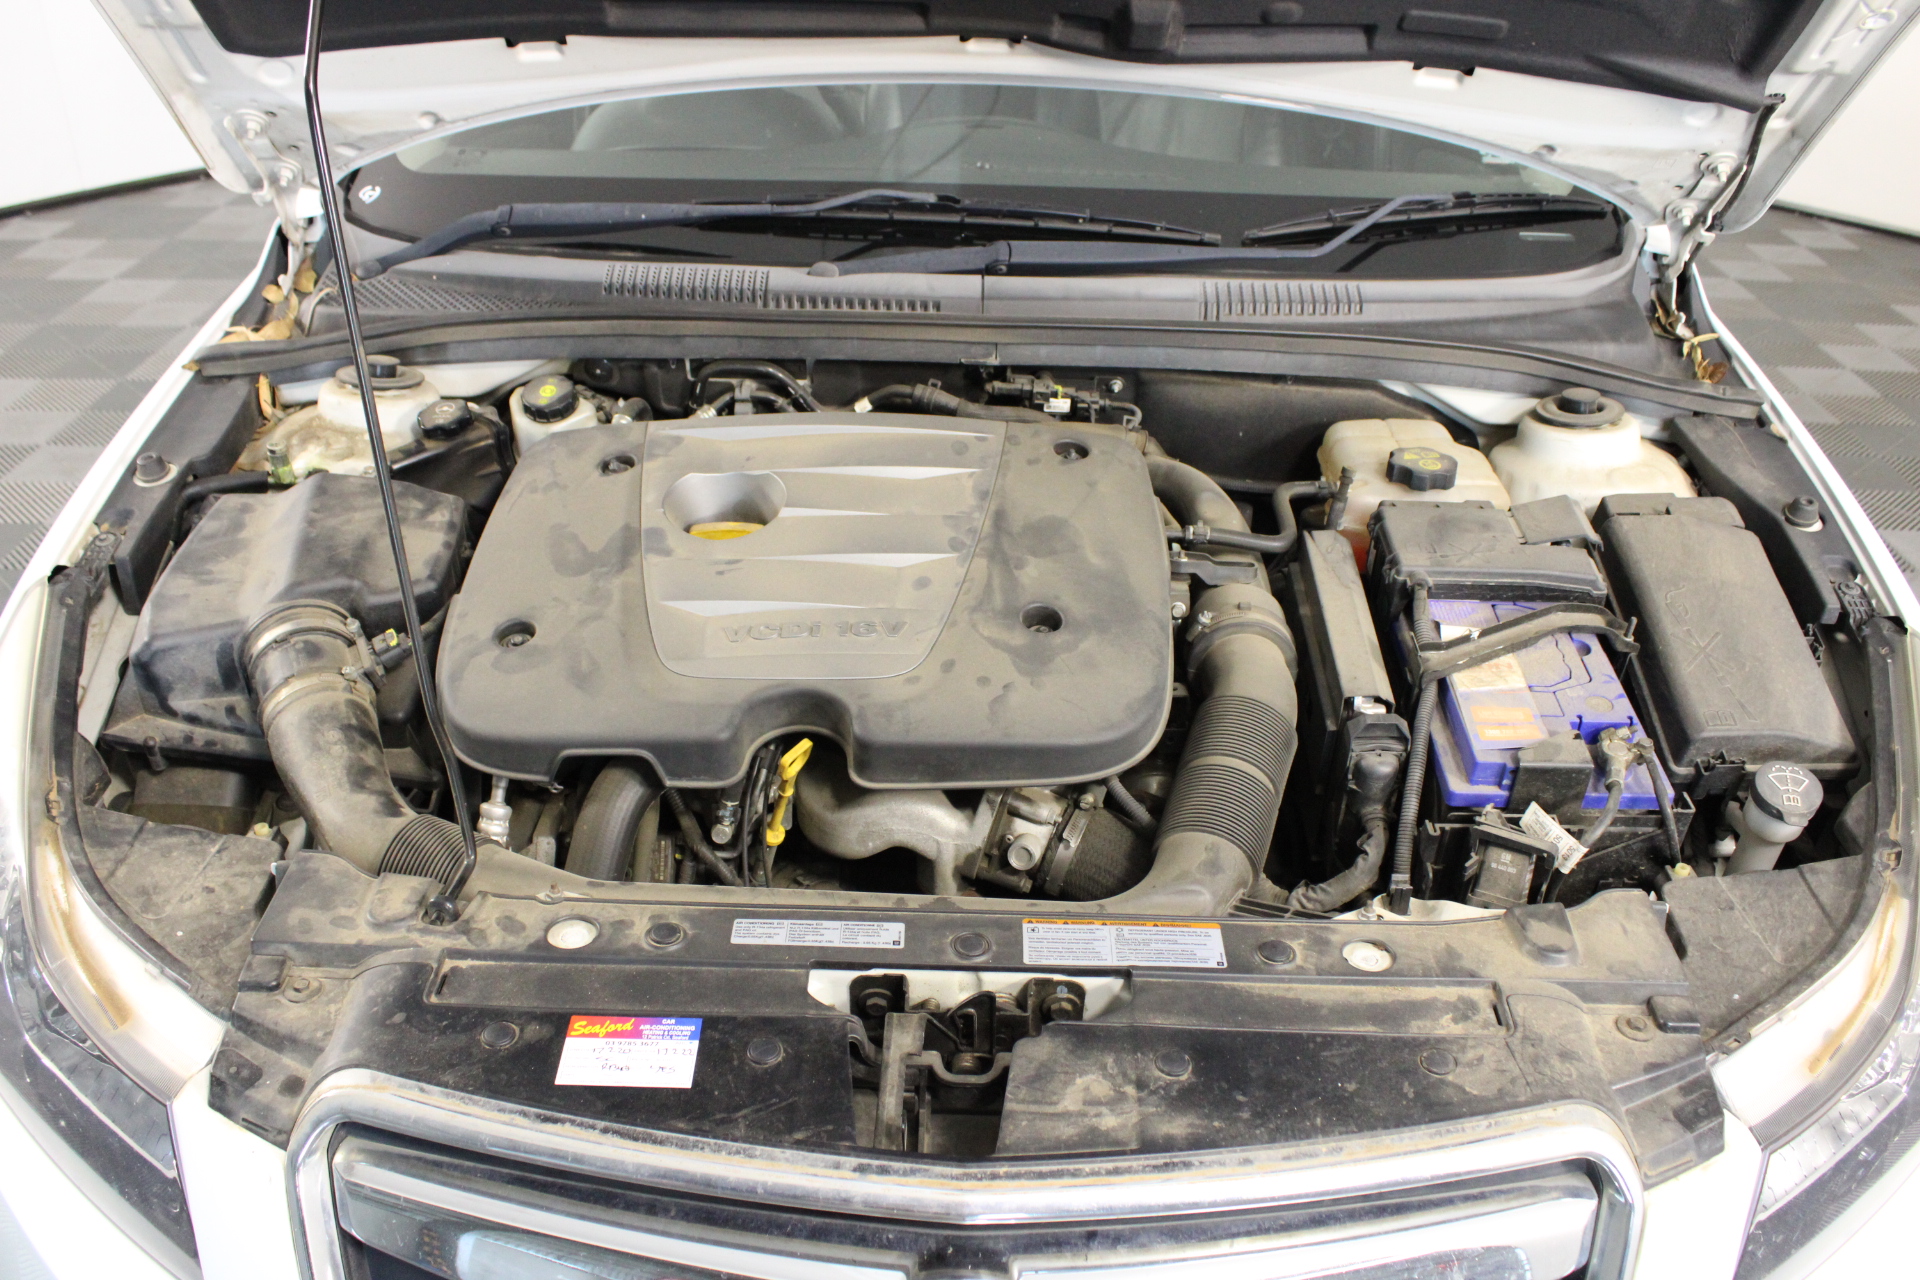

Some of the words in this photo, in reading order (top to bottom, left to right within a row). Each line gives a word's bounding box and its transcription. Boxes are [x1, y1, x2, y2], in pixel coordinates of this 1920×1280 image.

[723, 621, 821, 643] VCDi
[837, 620, 909, 638] 16V
[570, 1018, 636, 1038] Seaford
